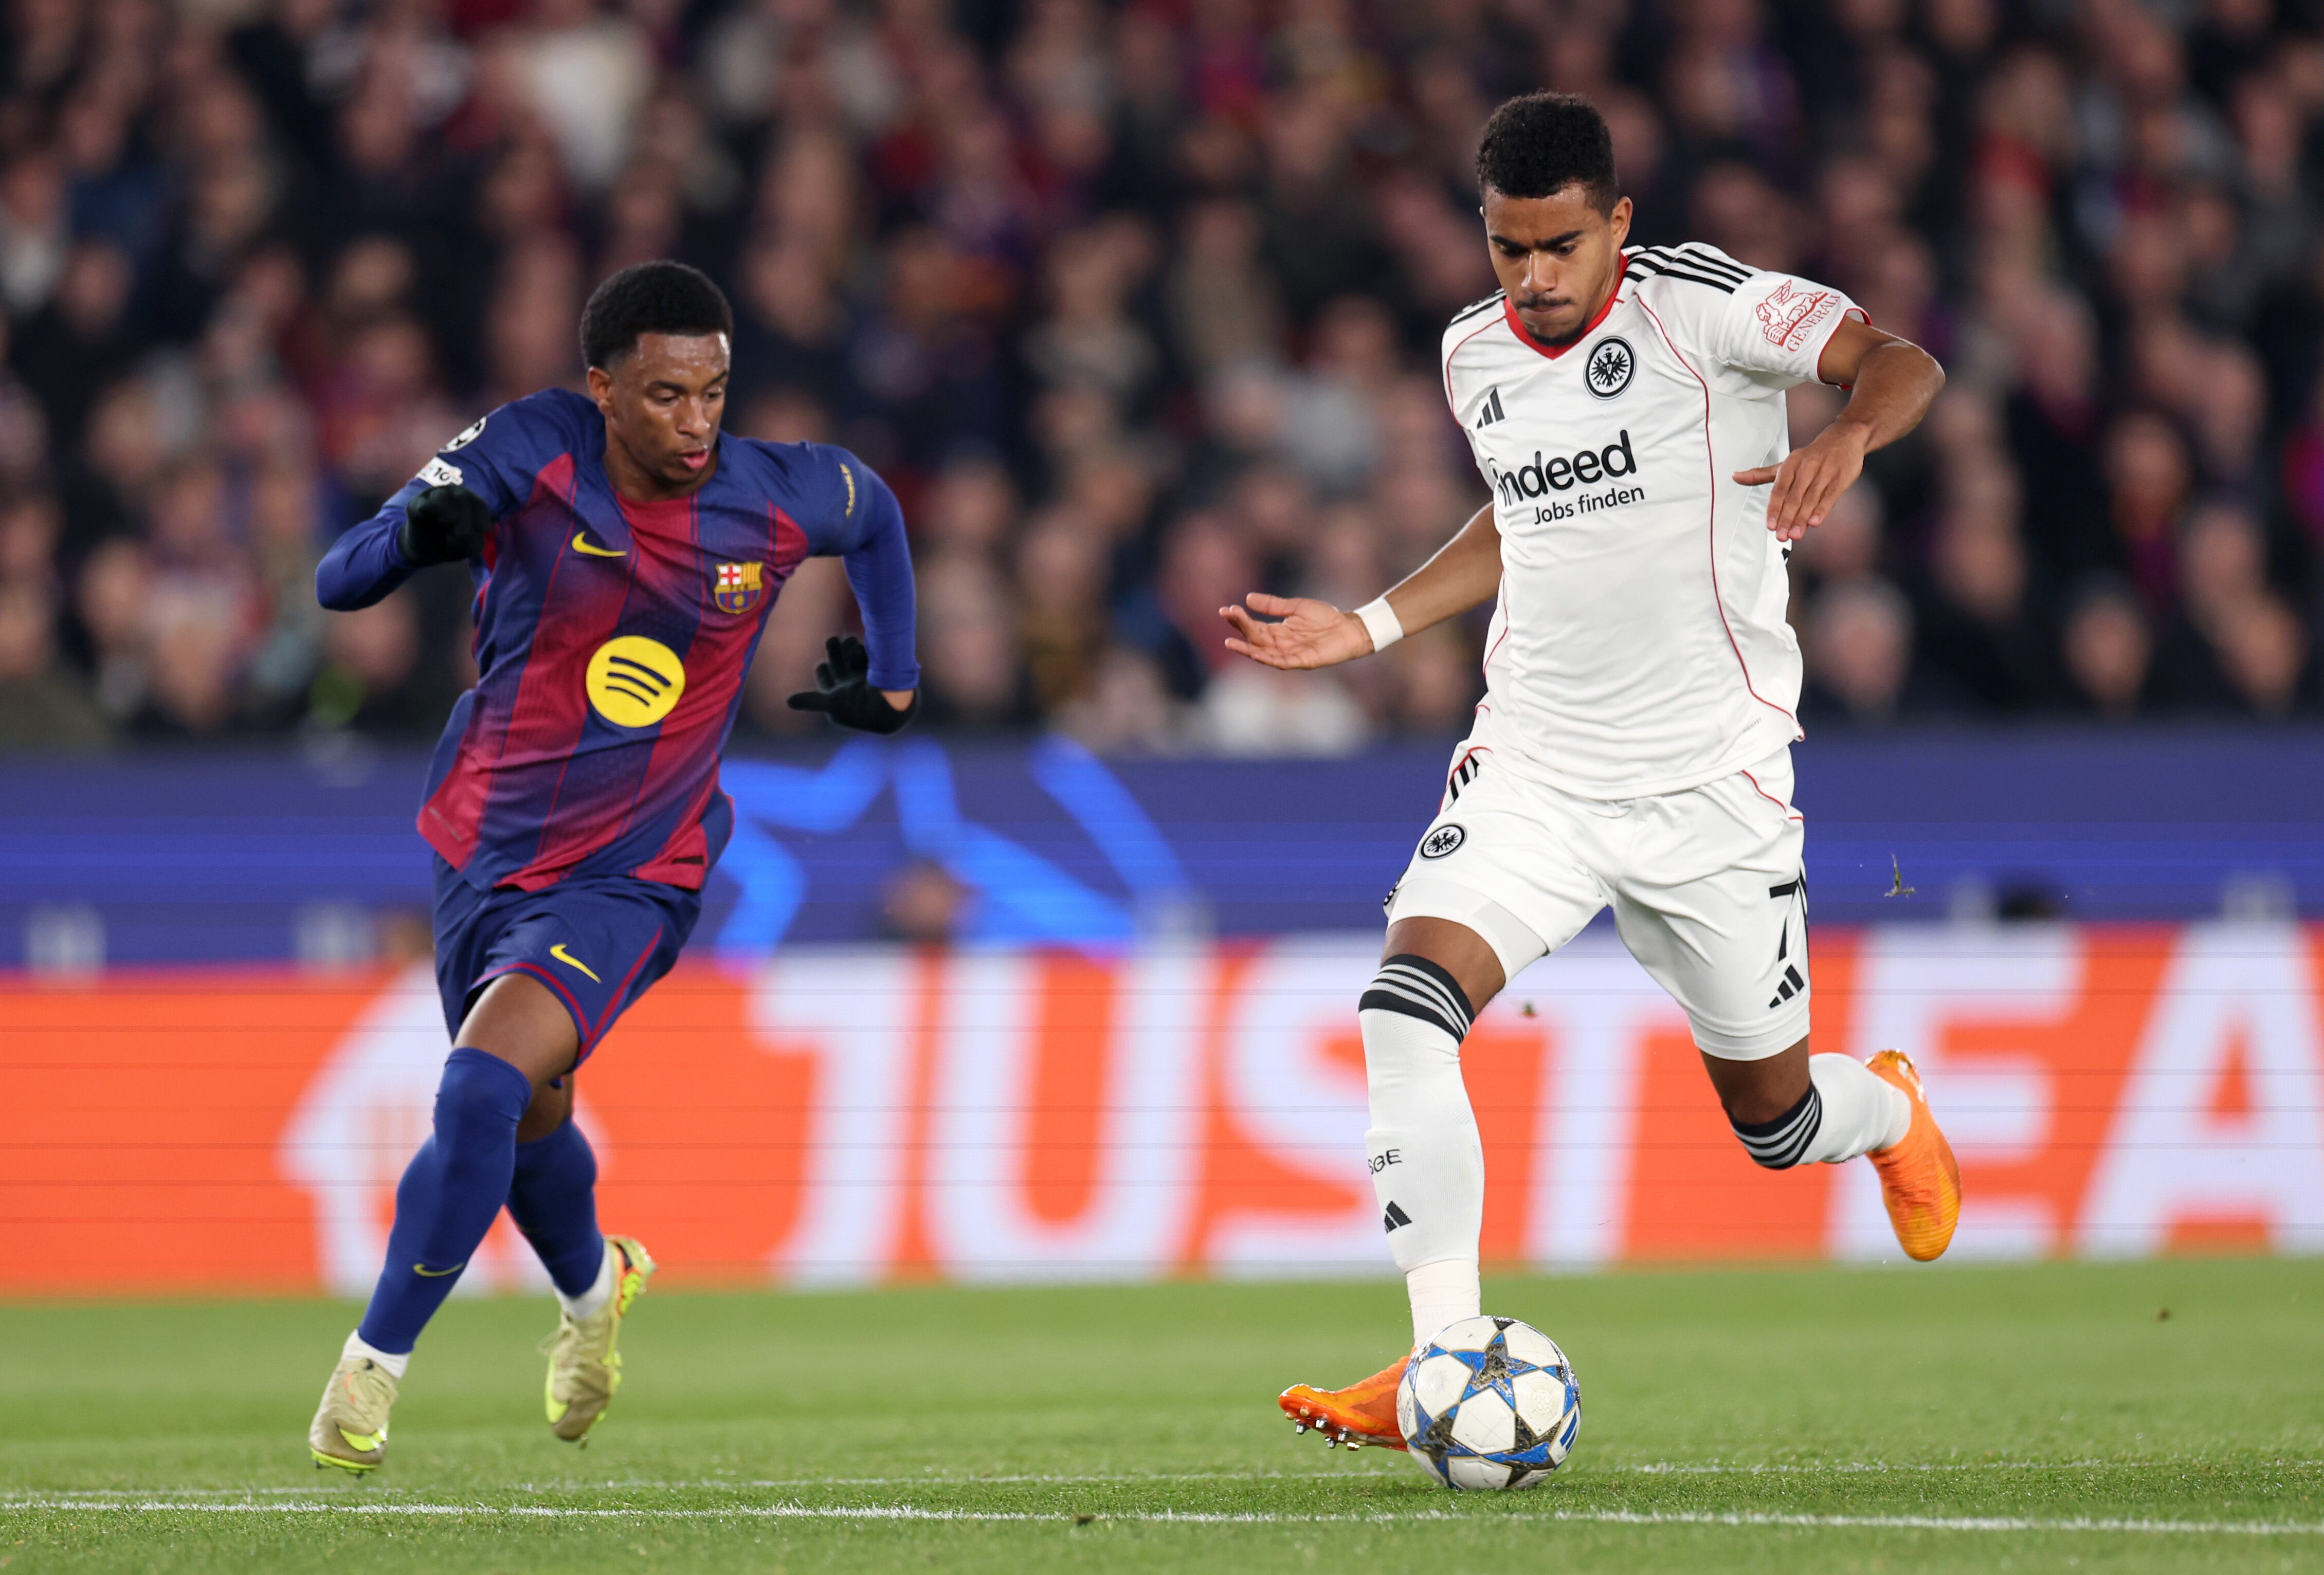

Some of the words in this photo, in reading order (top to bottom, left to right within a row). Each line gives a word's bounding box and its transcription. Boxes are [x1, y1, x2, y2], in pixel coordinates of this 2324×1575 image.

[1787, 295, 1841, 352] GENERALI
[1488, 429, 1637, 507] indeed
[1534, 502, 1574, 525] Jobs
[1578, 486, 1645, 514] finden
